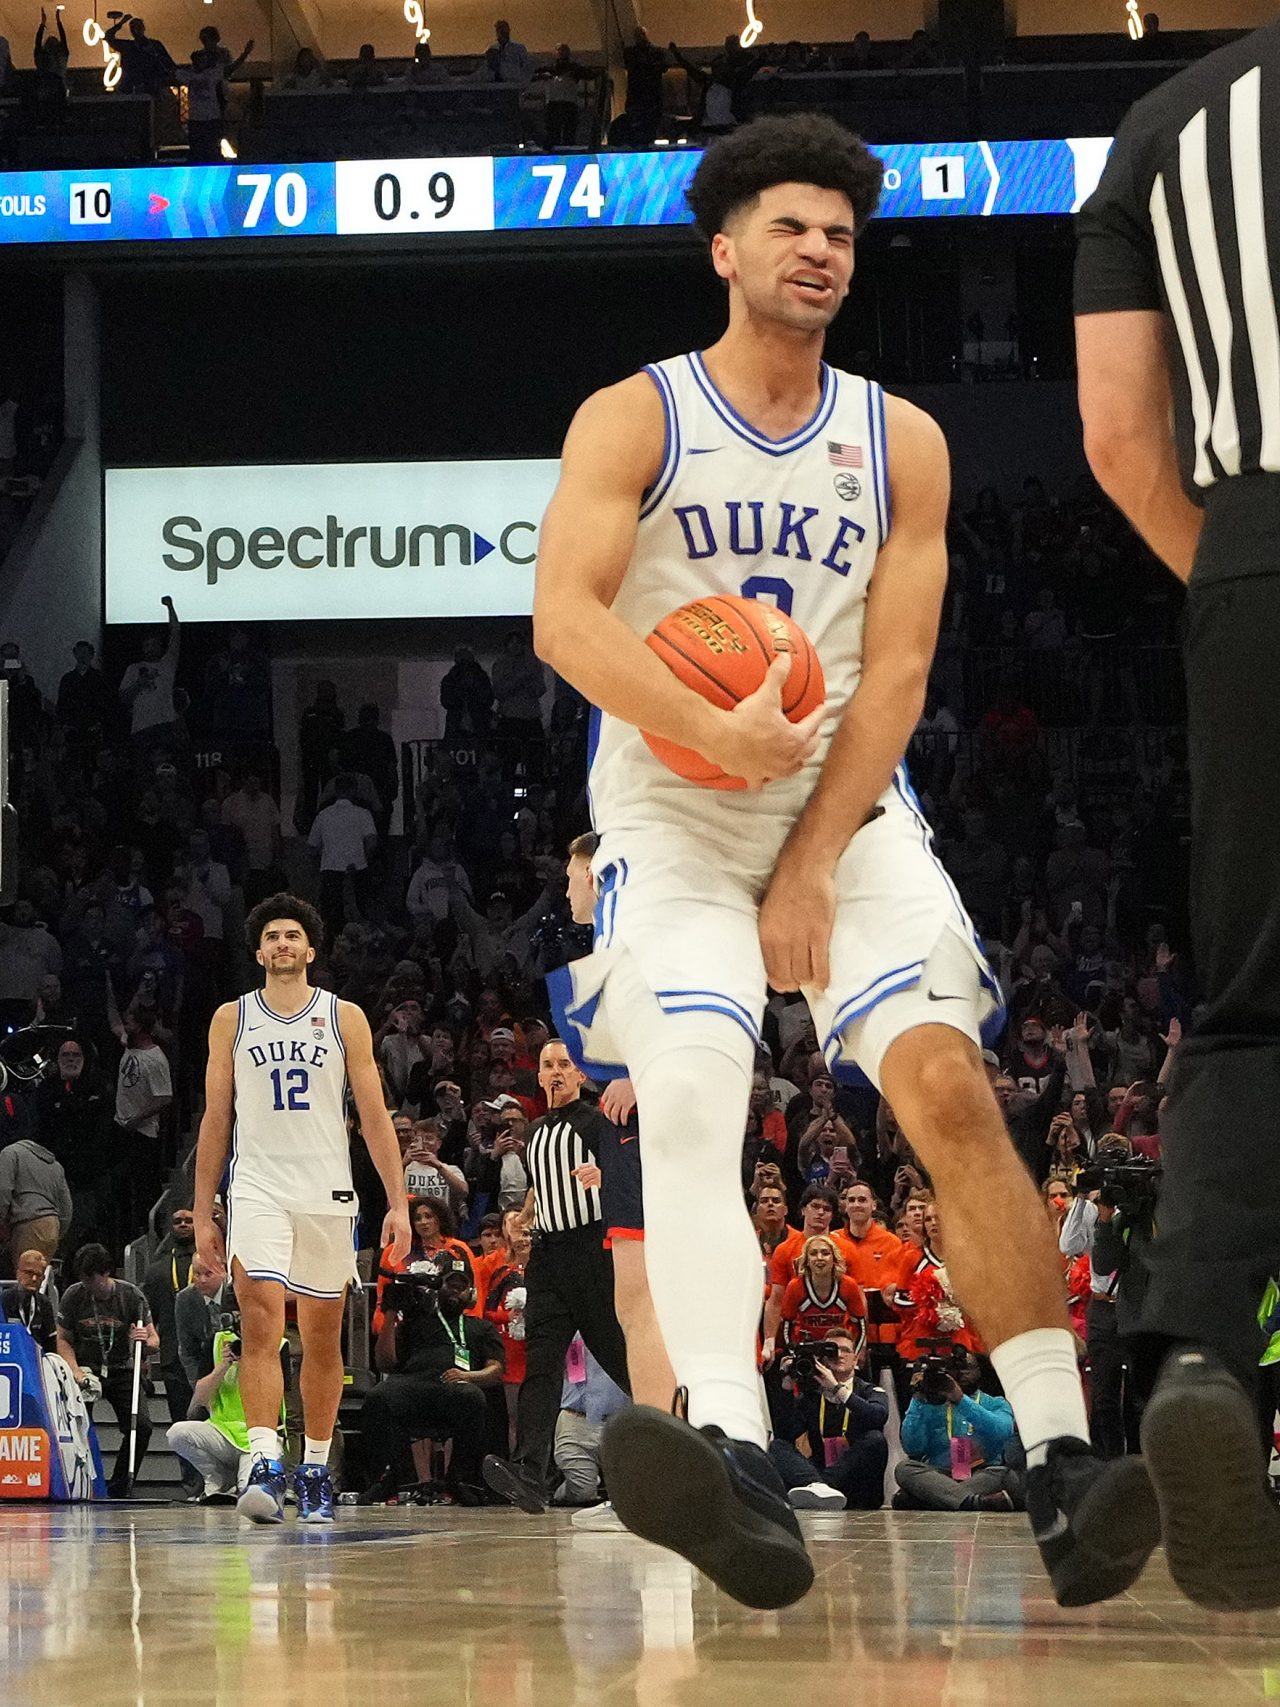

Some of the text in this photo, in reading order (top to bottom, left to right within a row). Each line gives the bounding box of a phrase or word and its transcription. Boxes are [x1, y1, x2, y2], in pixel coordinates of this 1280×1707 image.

[236, 172, 308, 228] 70
[373, 171, 456, 221] 0.9
[532, 163, 605, 220] 74
[935, 163, 949, 193] 1
[74, 188, 112, 219] 10
[162, 514, 472, 585] Spectrum
[672, 501, 866, 577] DUKE
[247, 1040, 330, 1068] DUKE
[270, 1068, 311, 1111] 12
[408, 1174, 448, 1187] DUKE
